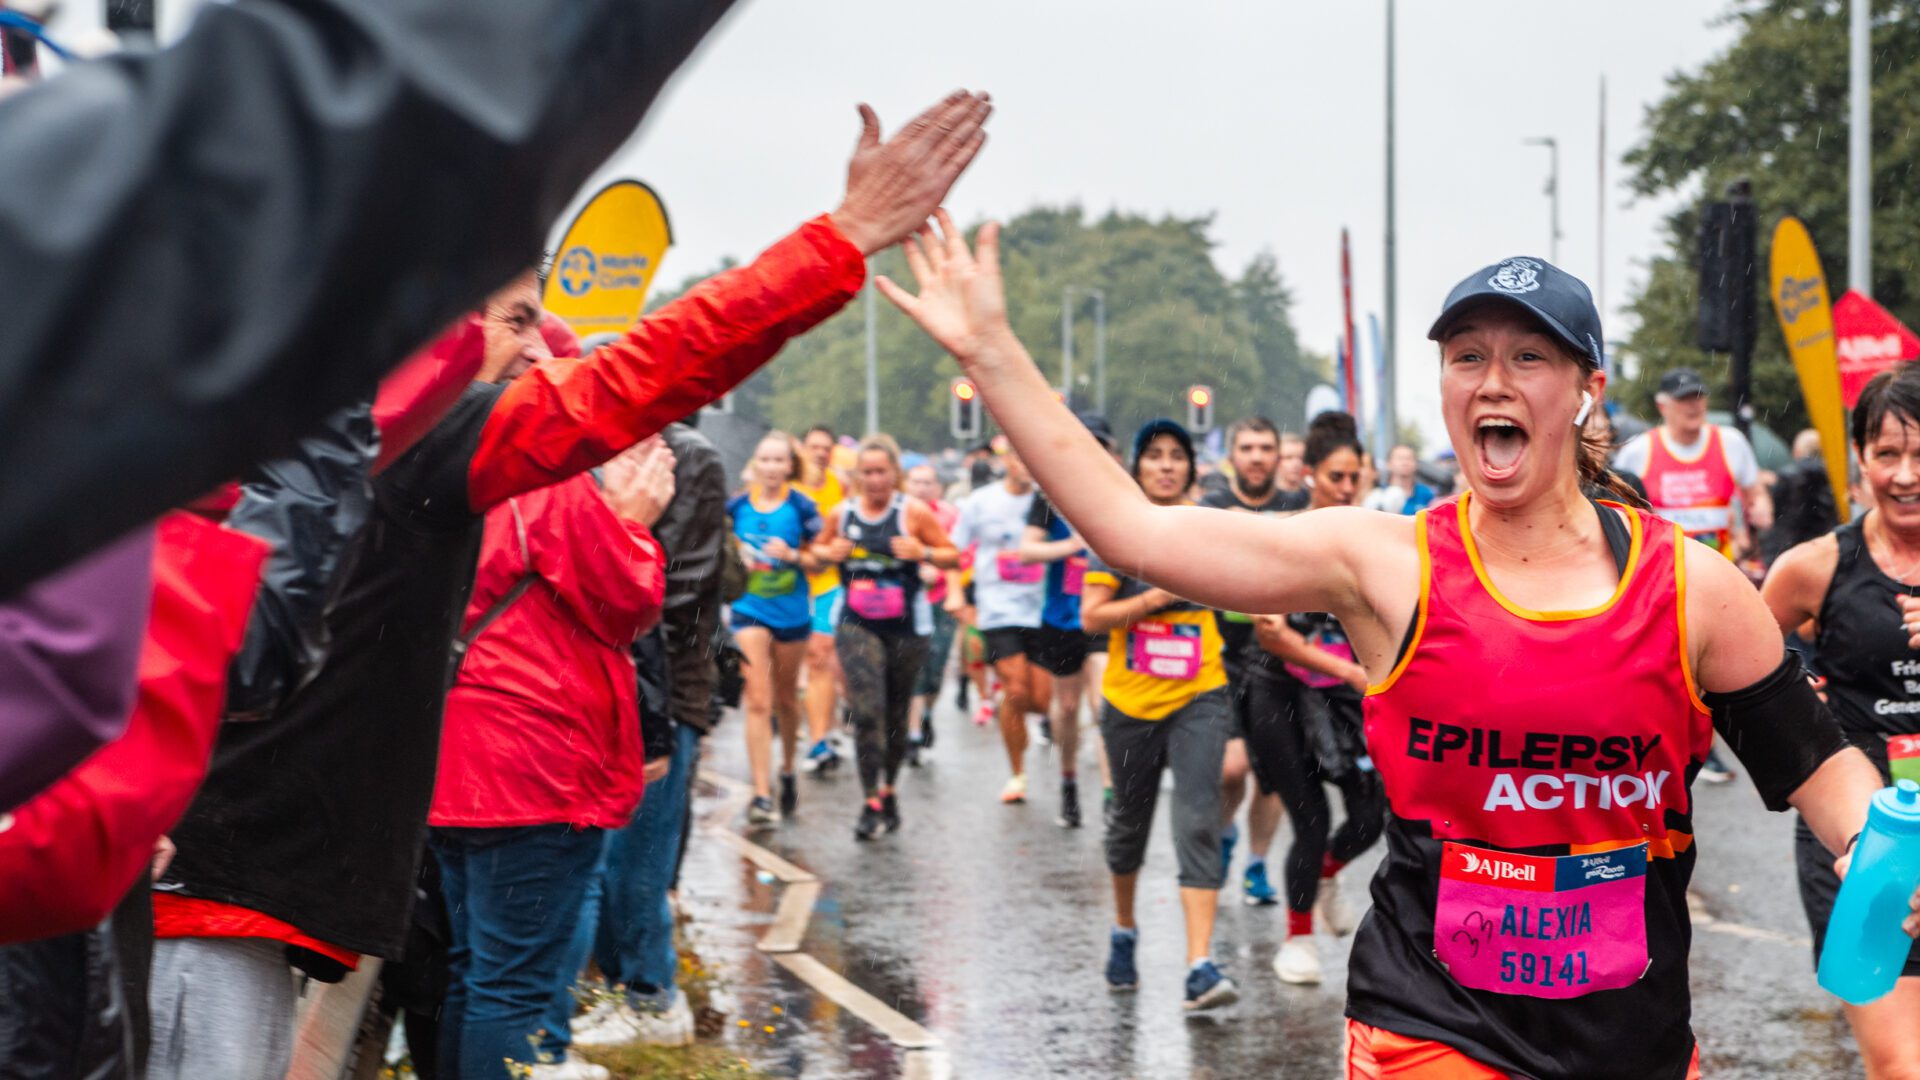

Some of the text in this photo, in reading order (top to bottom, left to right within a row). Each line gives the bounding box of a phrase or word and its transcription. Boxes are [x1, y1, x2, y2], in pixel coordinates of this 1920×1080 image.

[601, 253, 648, 269] Marie
[600, 273, 642, 290] Curie
[1407, 717, 1661, 771] EPILEPSY
[1483, 771, 1670, 811] ACTION
[1500, 901, 1592, 940] ALEXIA
[1500, 951, 1590, 987] 59141
